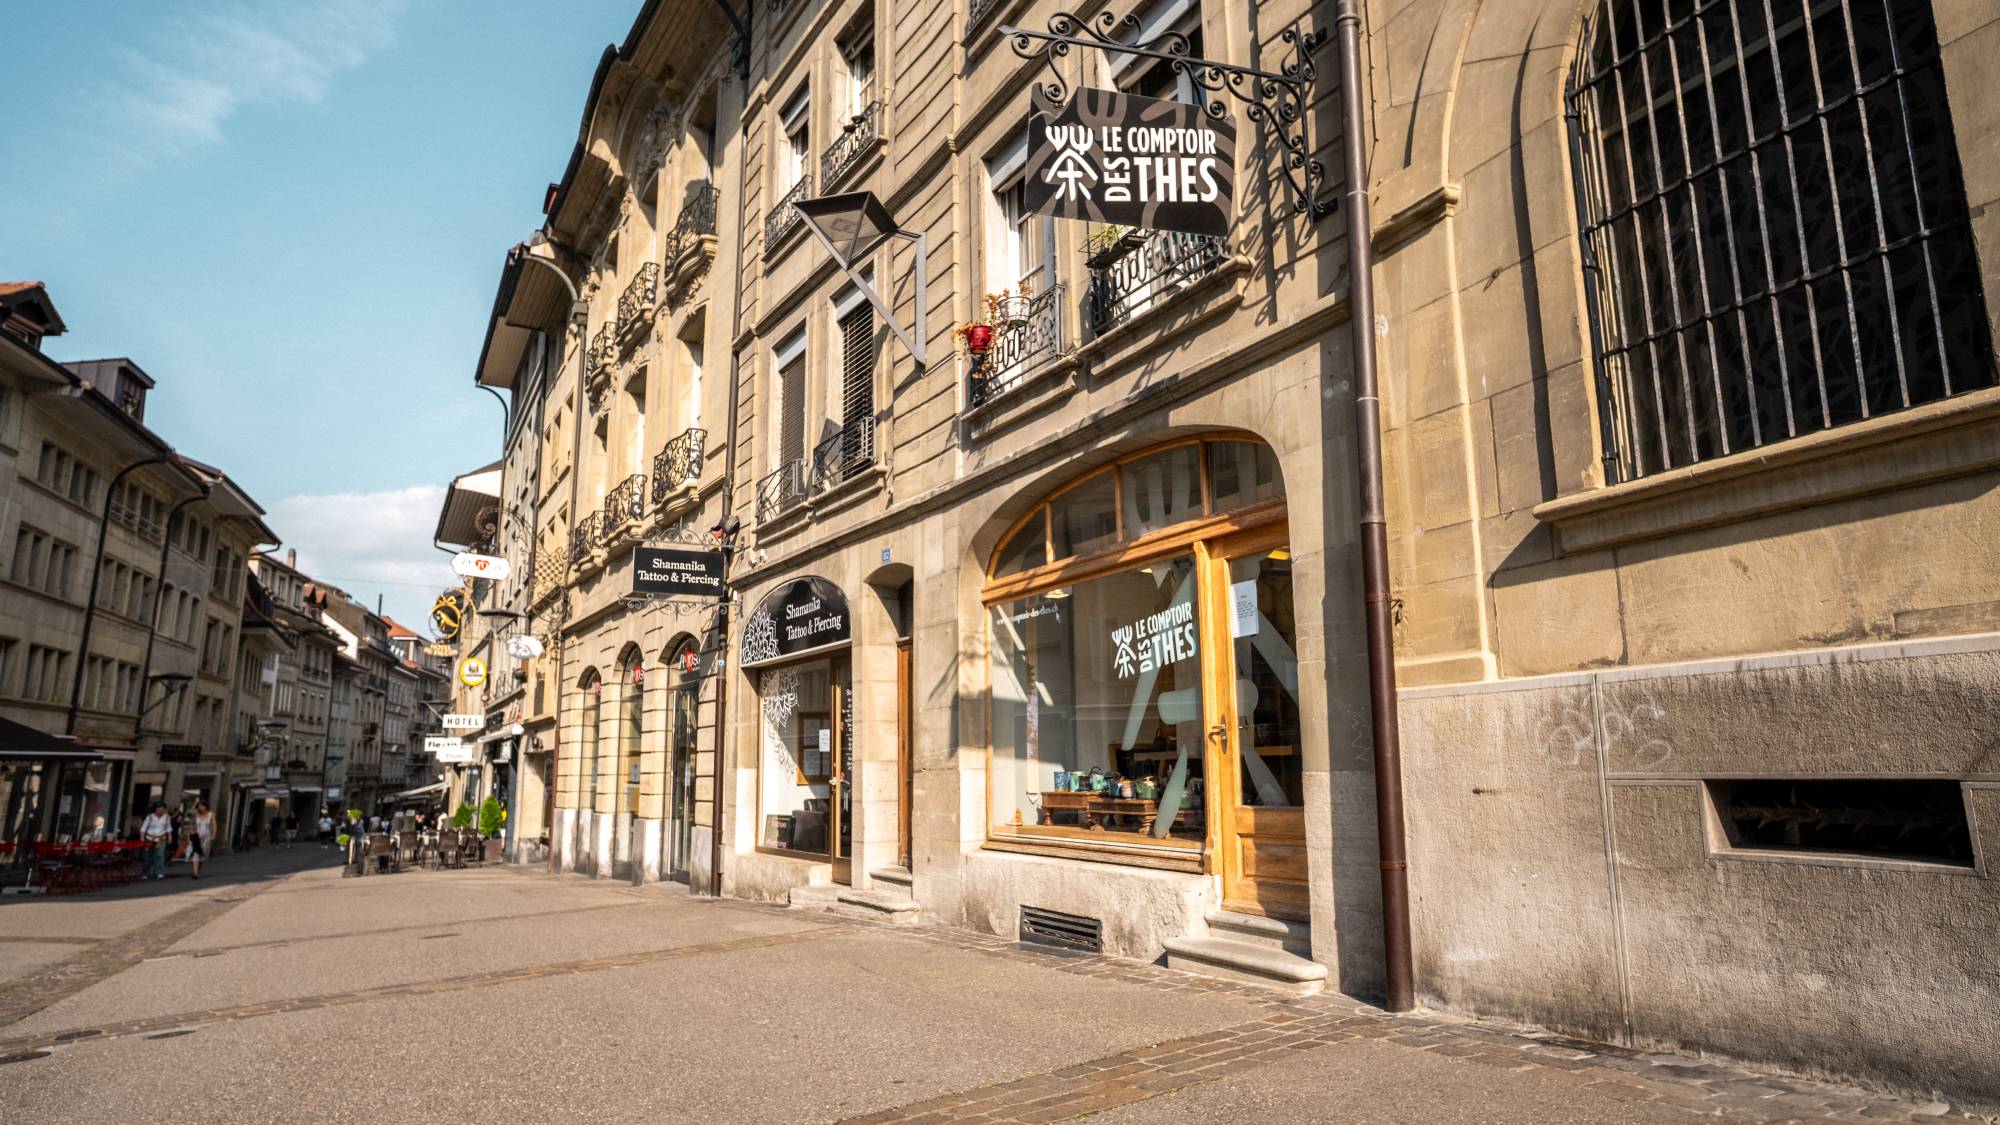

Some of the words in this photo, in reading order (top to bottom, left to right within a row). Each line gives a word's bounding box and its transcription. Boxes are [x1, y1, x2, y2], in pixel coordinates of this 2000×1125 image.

[1102, 126, 1123, 152] LE
[1127, 127, 1217, 155] COMPTOIR
[1103, 156, 1131, 202] DES
[1133, 156, 1219, 203] THES
[637, 570, 669, 582] Tattoo
[670, 571, 679, 582] &
[681, 573, 720, 587] Piercing
[652, 558, 706, 572] Shamanika
[786, 596, 821, 620] Shamanika
[1135, 619, 1147, 639] LE
[1147, 602, 1193, 635] COMPTOIR
[786, 625, 808, 641] Tattoo
[807, 619, 813, 635] &
[813, 612, 842, 633] Piercing
[1137, 639, 1153, 673] DES
[1152, 623, 1197, 668] THES
